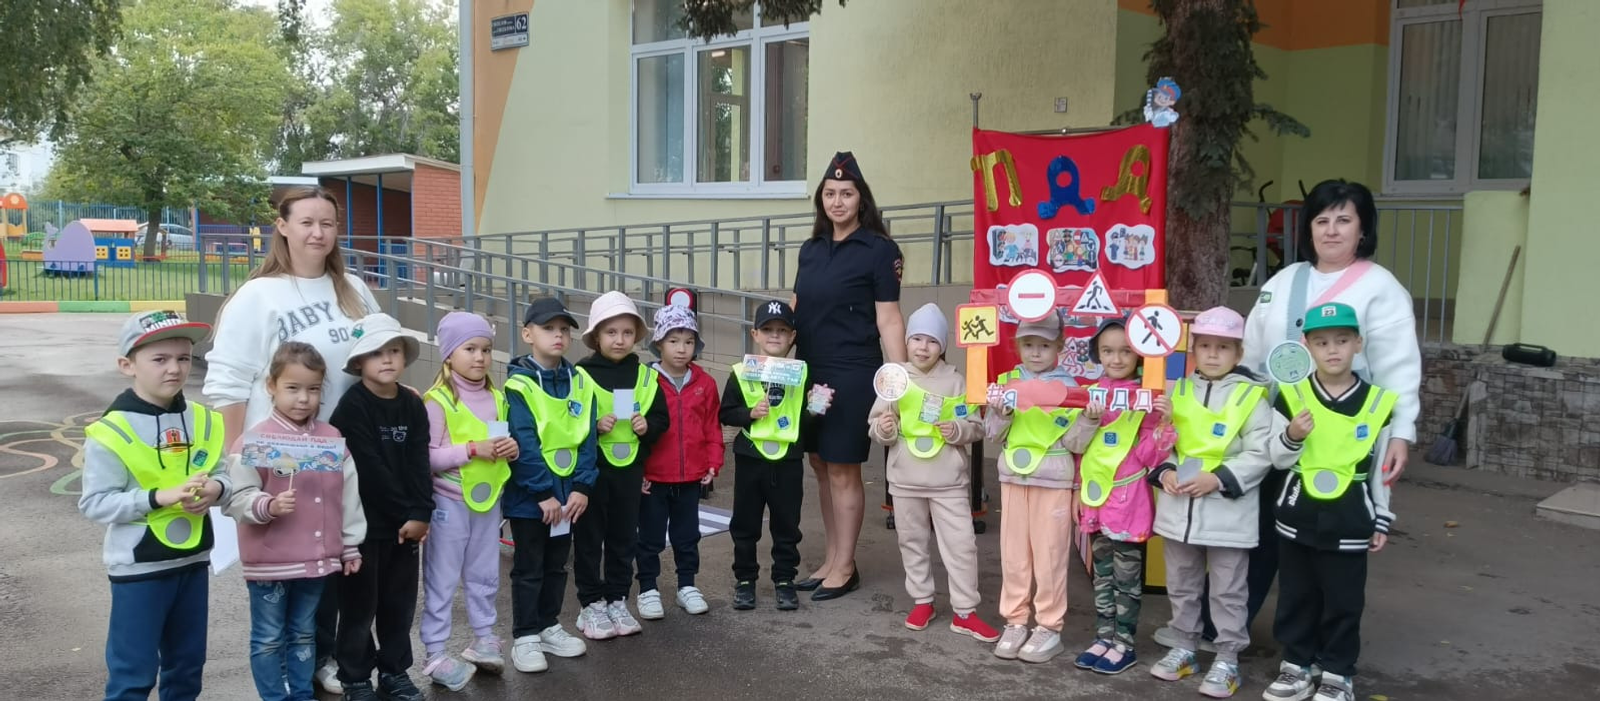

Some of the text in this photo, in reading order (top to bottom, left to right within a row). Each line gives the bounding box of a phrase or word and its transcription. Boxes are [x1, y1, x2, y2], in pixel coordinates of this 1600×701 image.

[516, 16, 527, 30] 62
[970, 144, 1152, 219] ПДД
[277, 301, 335, 341] BABY
